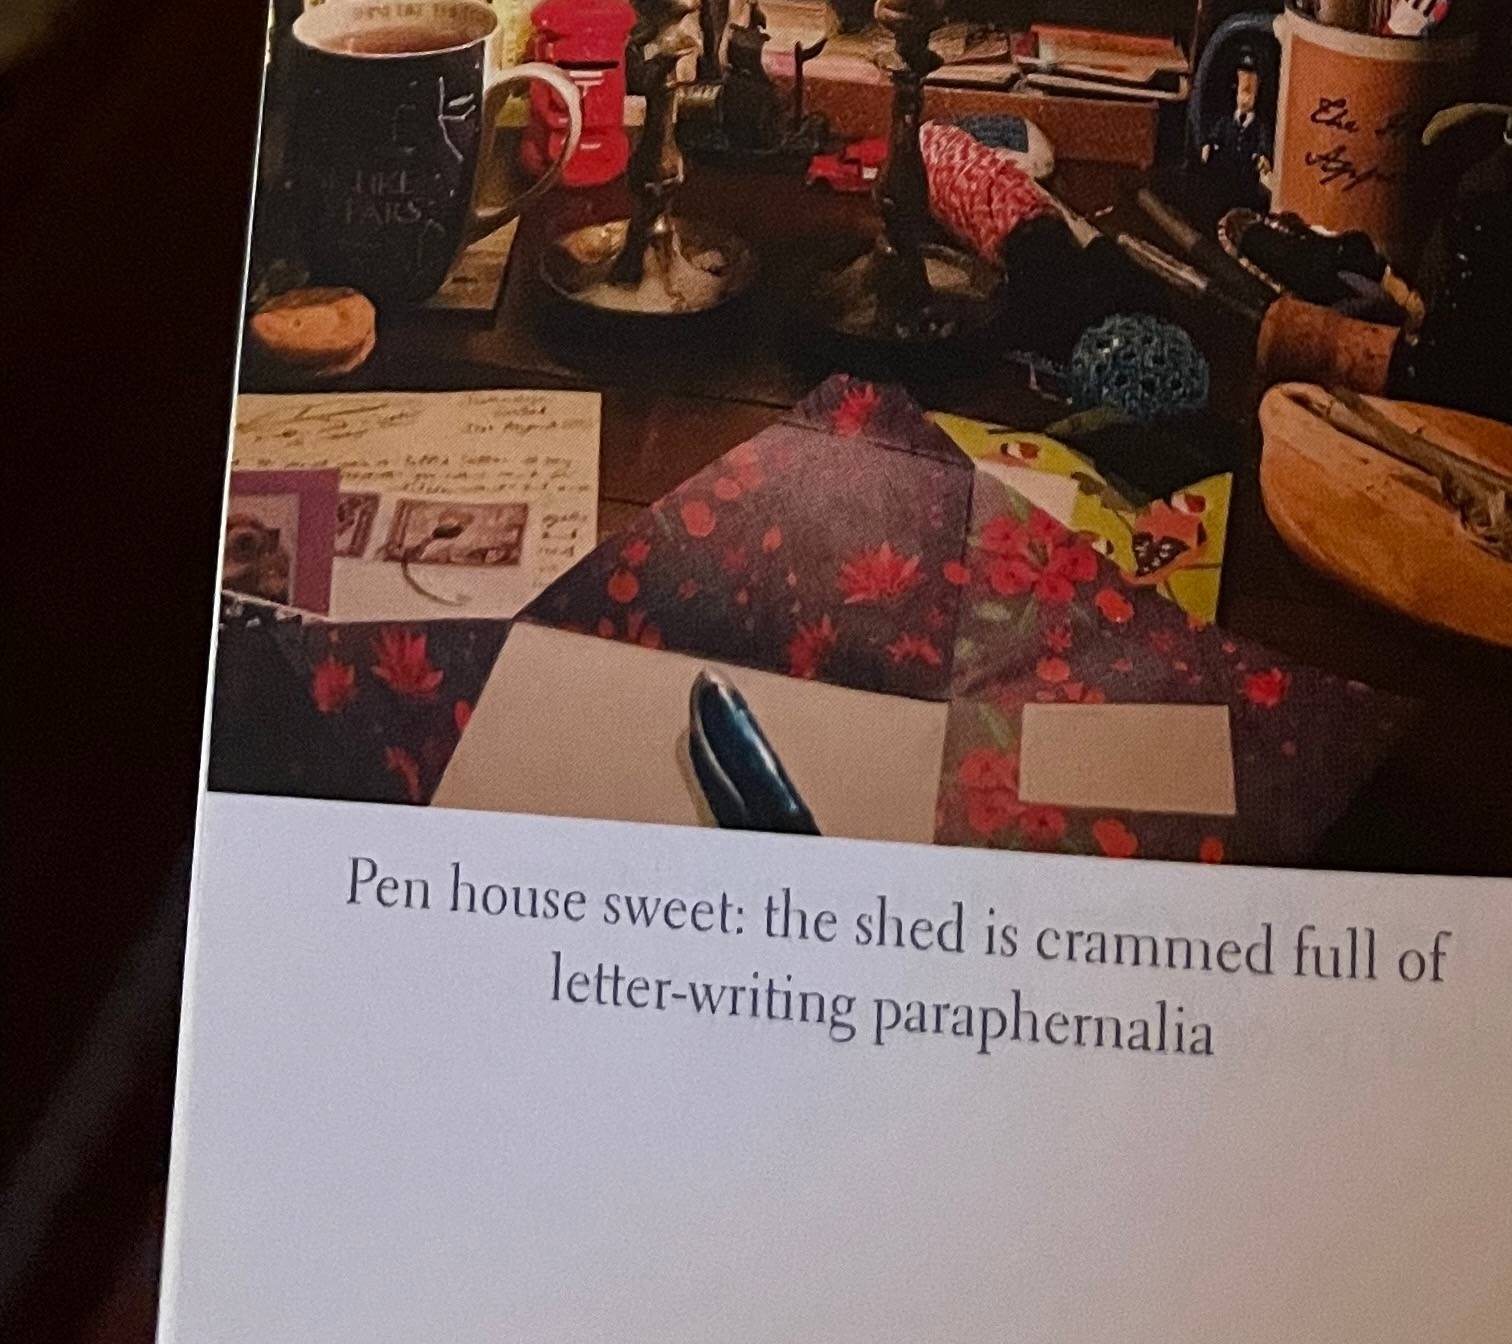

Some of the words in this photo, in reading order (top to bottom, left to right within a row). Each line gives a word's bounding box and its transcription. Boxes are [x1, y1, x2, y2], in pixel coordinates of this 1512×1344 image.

[347, 856, 431, 910] Pen
[449, 861, 587, 922] house
[603, 891, 744, 935] sweet:
[765, 887, 838, 943] the
[855, 895, 965, 954] shed
[984, 907, 1018, 958] is
[1036, 922, 1274, 976] crammed
[1294, 924, 1377, 981] full
[1398, 930, 1453, 983] of
[551, 950, 857, 1044] letter-writing
[873, 988, 1215, 1057] paraphernalia
